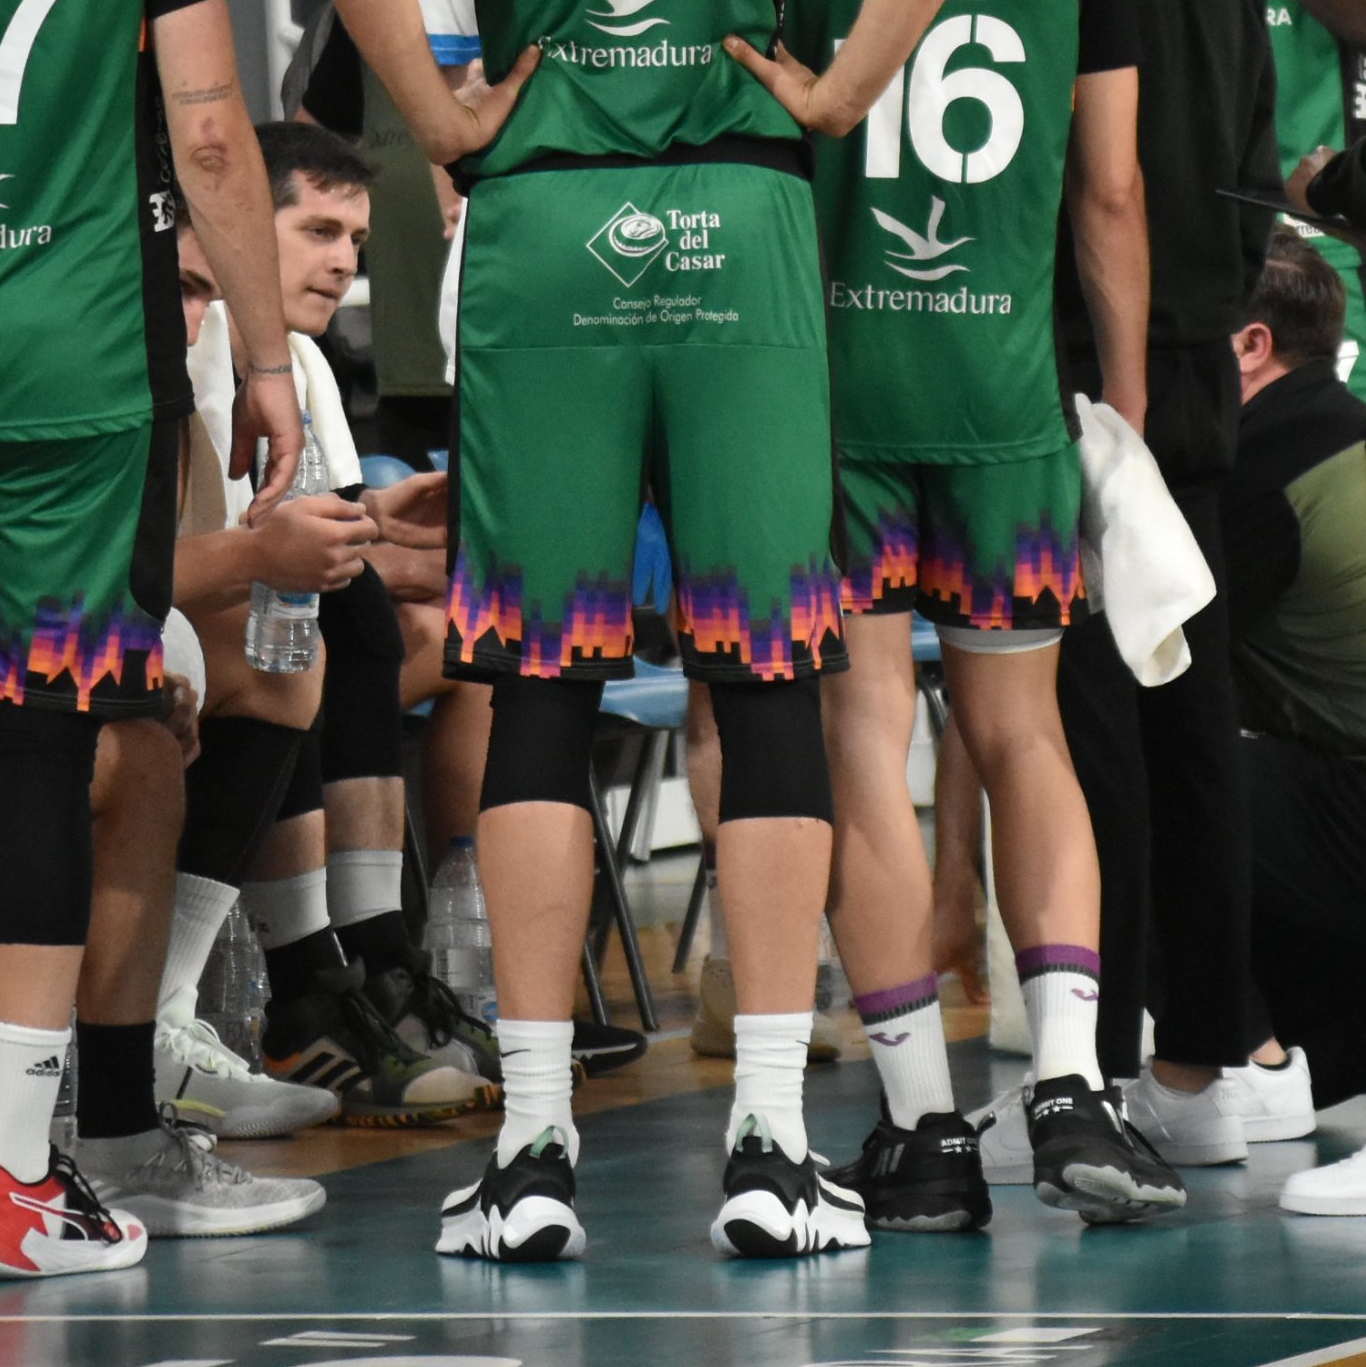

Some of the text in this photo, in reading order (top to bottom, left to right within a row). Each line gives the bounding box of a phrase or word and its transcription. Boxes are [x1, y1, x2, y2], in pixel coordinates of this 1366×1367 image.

[835, 14, 1026, 183] 16
[666, 209, 720, 229] Torta
[679, 229, 709, 250] del
[665, 251, 726, 272] Casar
[613, 294, 702, 311] Consejo Regulador
[829, 282, 1012, 314] Extremadura
[573, 308, 739, 326] Denominación de Origen Protegida
